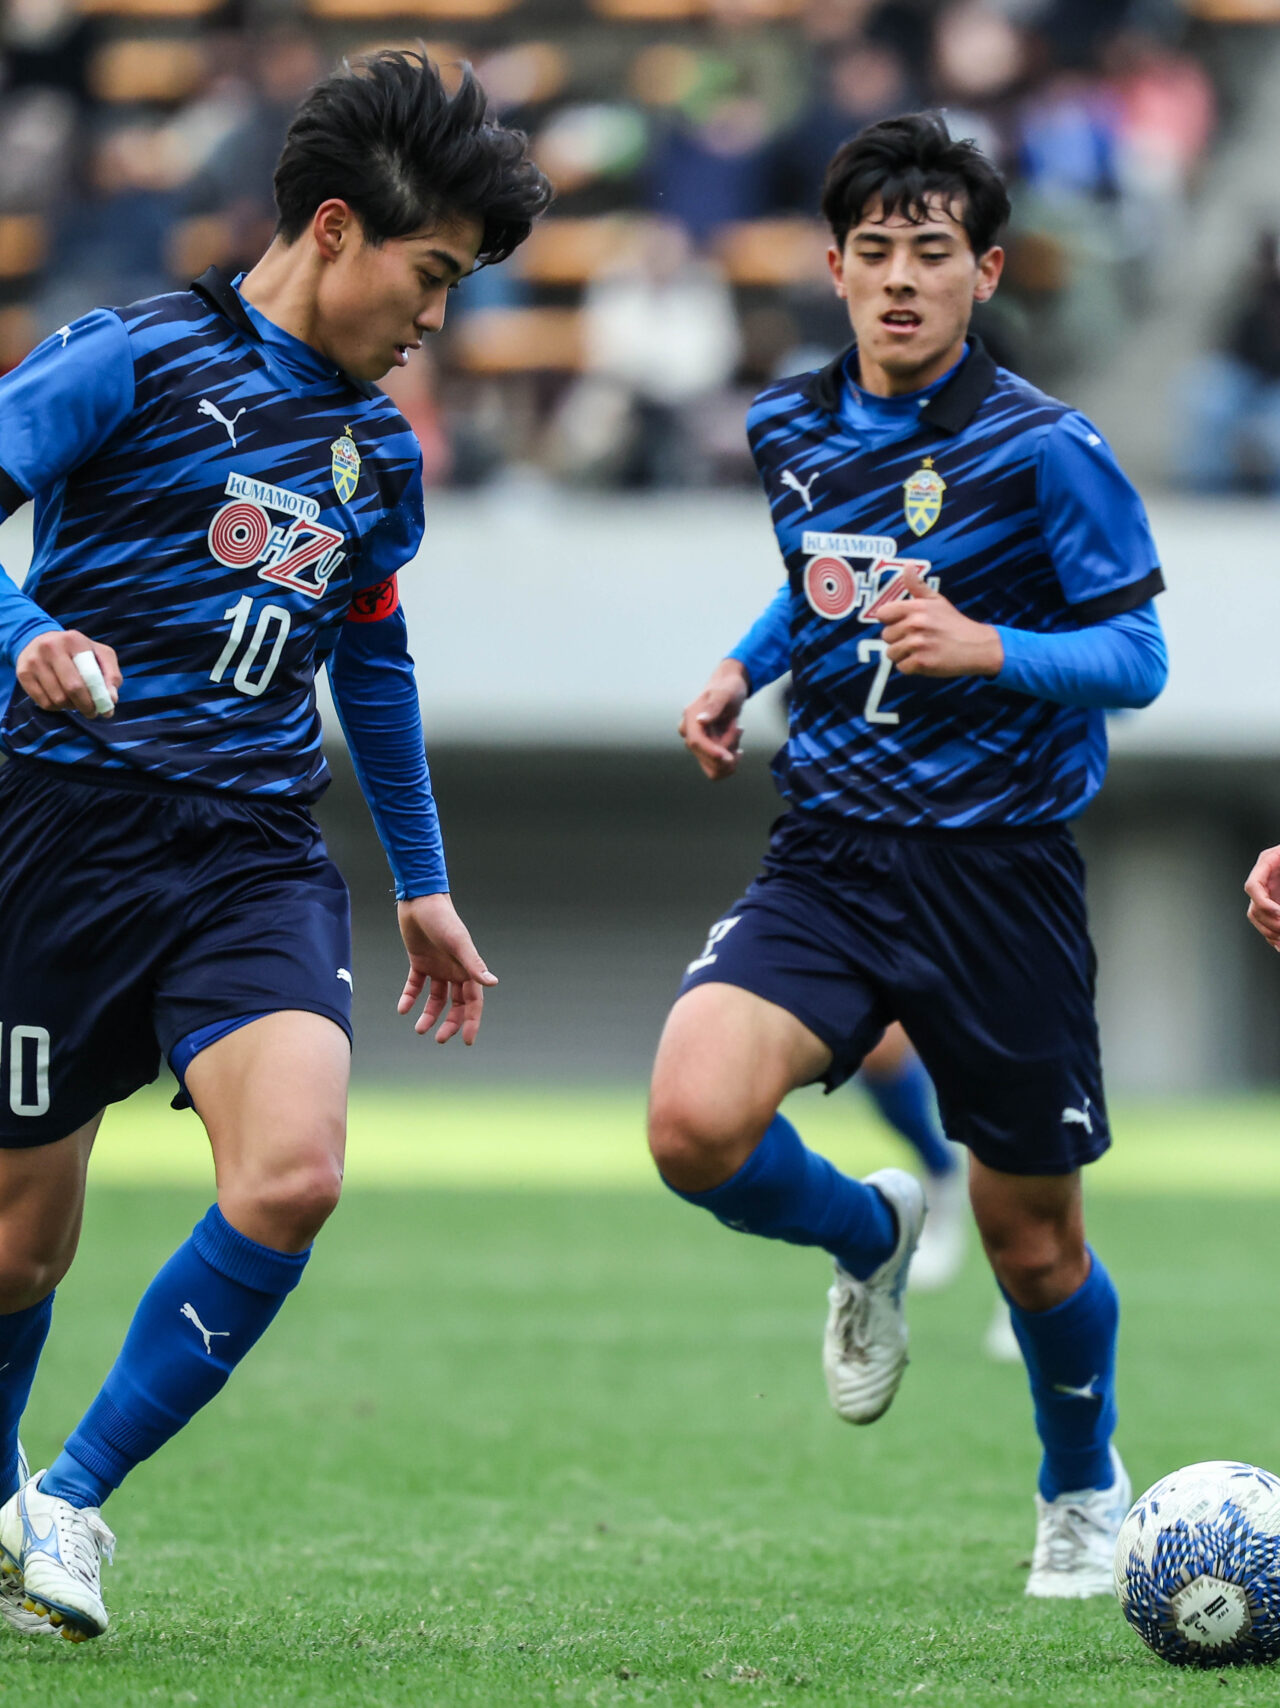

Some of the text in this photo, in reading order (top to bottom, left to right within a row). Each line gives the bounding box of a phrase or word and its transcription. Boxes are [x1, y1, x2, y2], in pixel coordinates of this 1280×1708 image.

[229, 475, 318, 519] KUMAMOTO
[806, 536, 895, 556] KUMAMOTO
[209, 594, 292, 697] 10
[857, 639, 900, 724] 2
[0, 1021, 50, 1117] 0
